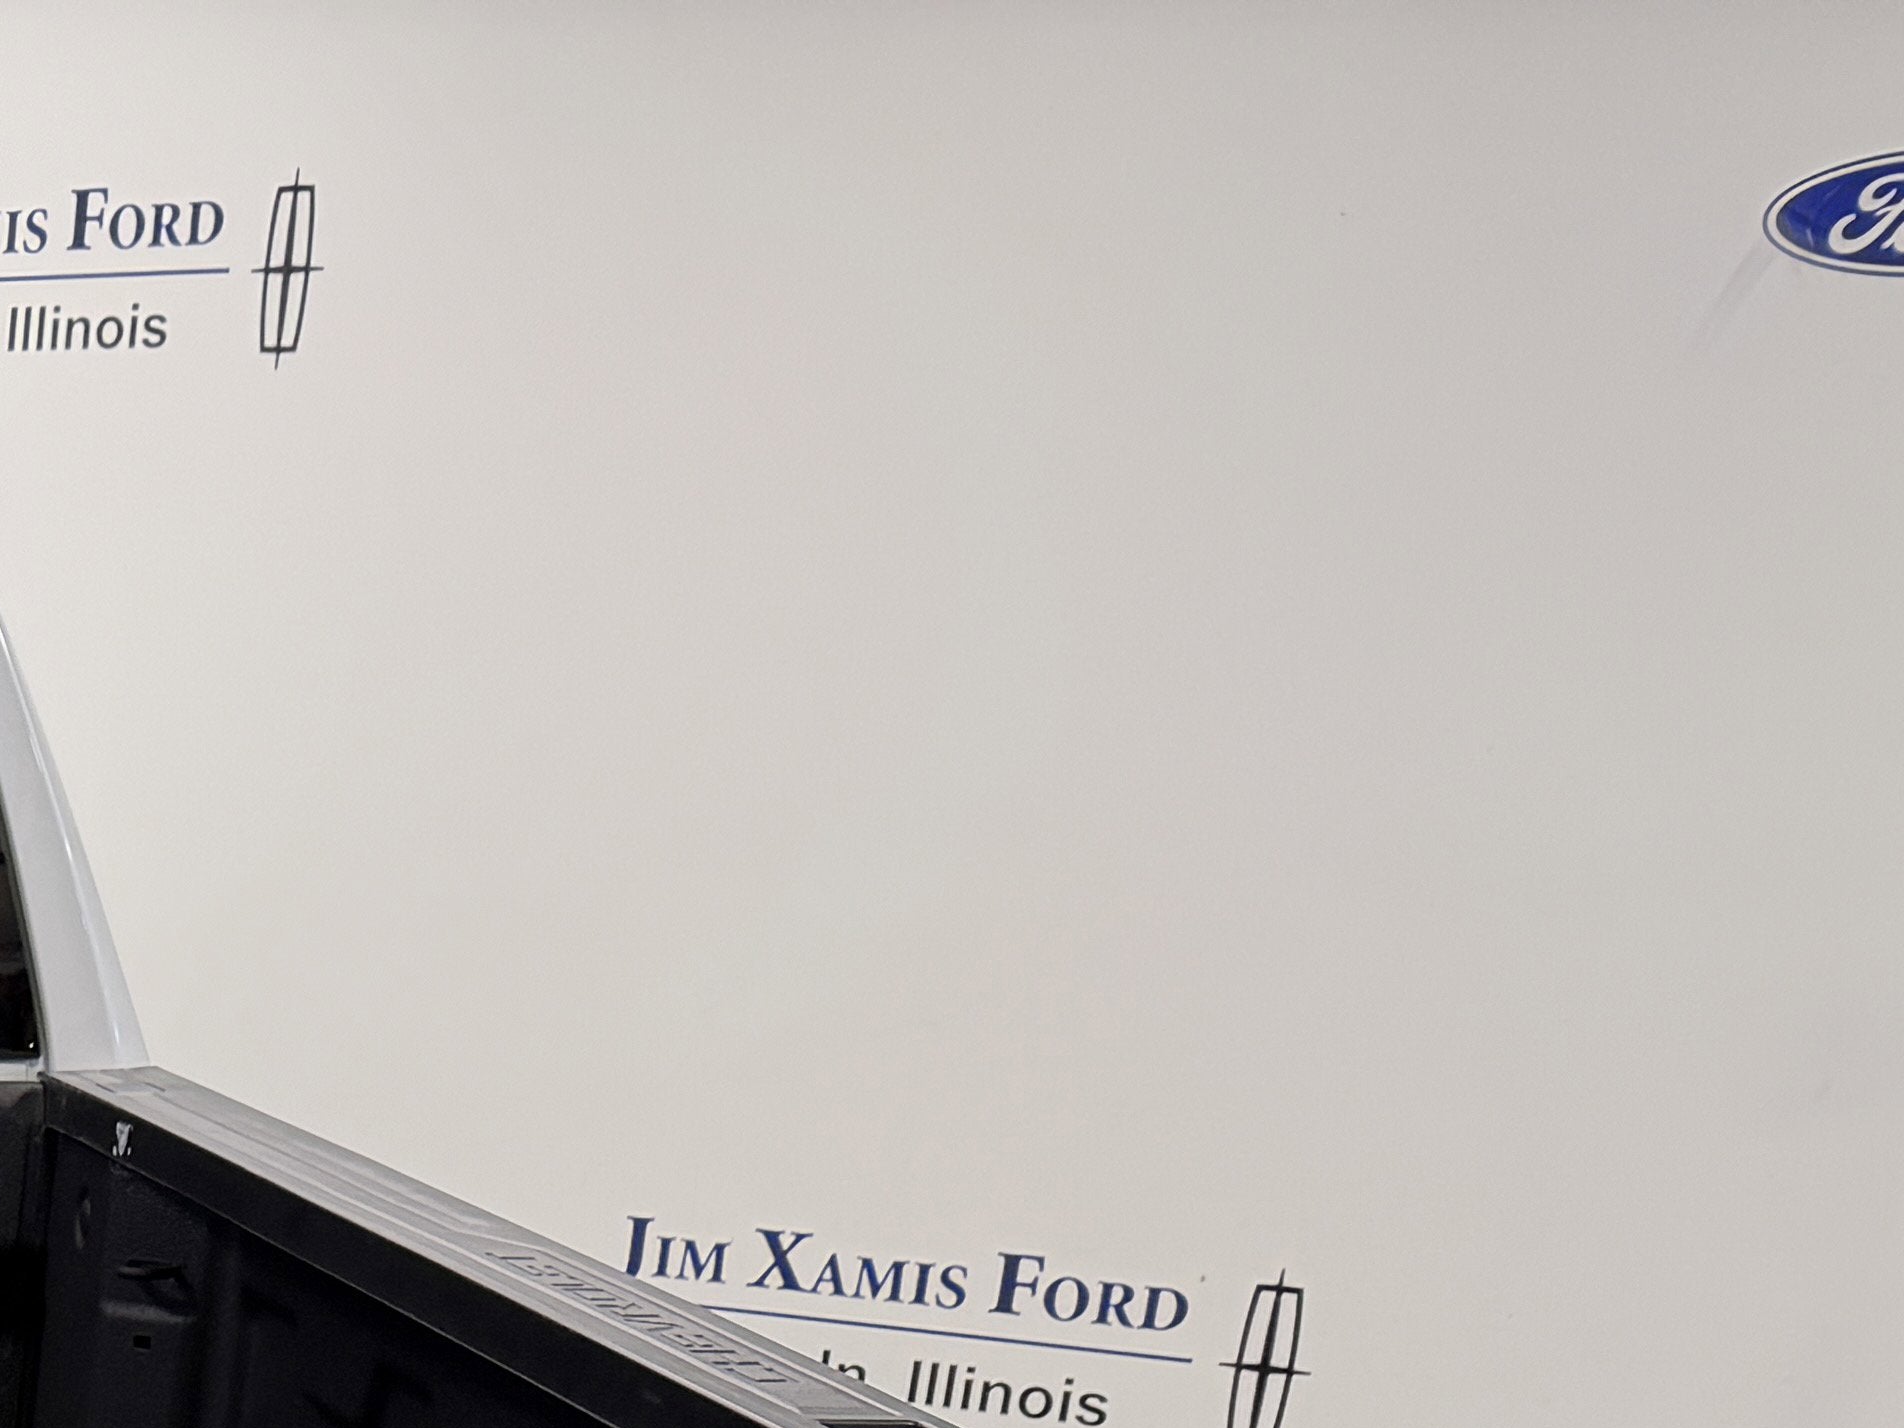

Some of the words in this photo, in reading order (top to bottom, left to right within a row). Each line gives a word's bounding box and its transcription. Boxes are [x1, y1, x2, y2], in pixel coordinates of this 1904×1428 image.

[67, 188, 225, 250] FORD
[7, 303, 168, 352] Illinois
[625, 1215, 732, 1284] JIM
[747, 1228, 968, 1309] XAMIS
[988, 1252, 1189, 1332] FORD
[908, 1360, 1109, 1426] Illinois
